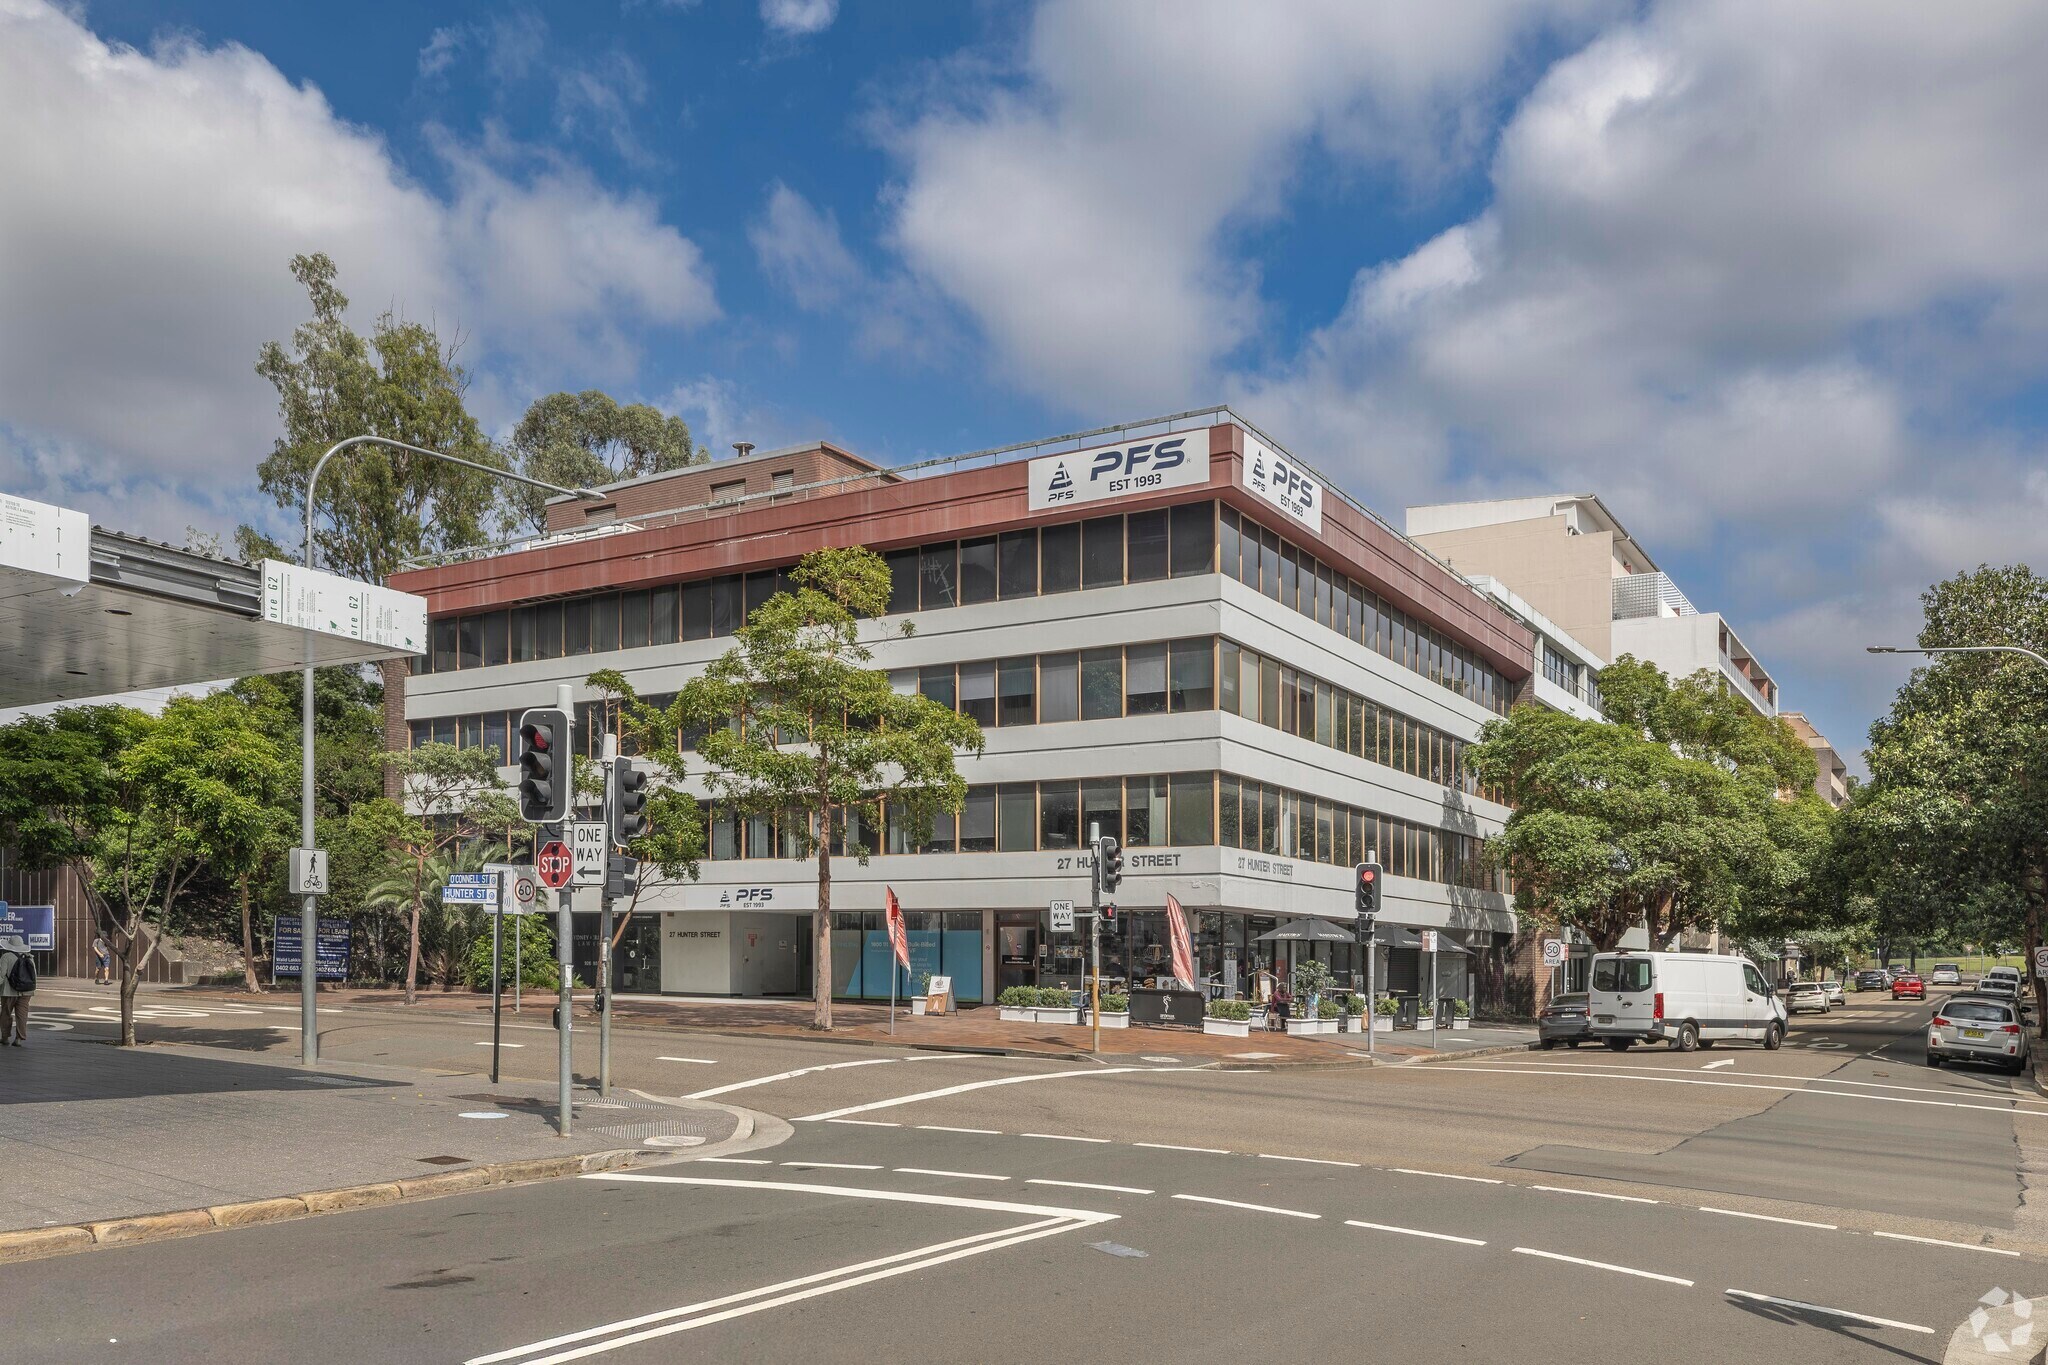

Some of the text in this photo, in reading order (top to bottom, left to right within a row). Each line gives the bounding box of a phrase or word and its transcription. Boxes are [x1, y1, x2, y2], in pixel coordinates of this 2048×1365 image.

[1089, 437, 1187, 481] PFS
[1109, 473, 1162, 493] EST 1993
[1252, 478, 1266, 493] PFS
[1272, 461, 1314, 508] PFS
[1048, 490, 1075, 502] PFS
[1280, 493, 1304, 517] EST 1993
[268, 576, 278, 591] G2
[348, 595, 359, 609] G2
[578, 828, 602, 842] ONE
[576, 848, 602, 862] WAY
[1057, 858, 1072, 870] 27
[1132, 854, 1181, 867] STREET
[541, 857, 570, 873] STOP
[1237, 857, 1294, 876] 27 HUNTER STREET
[450, 874, 489, 884] O'CONNELL ST
[444, 888, 486, 898] HUNTER ST
[518, 885, 531, 896] 60
[736, 888, 773, 901] PFS
[1054, 902, 1070, 910] ONE
[1053, 912, 1071, 920] WAY
[1547, 945, 1558, 954] 50
